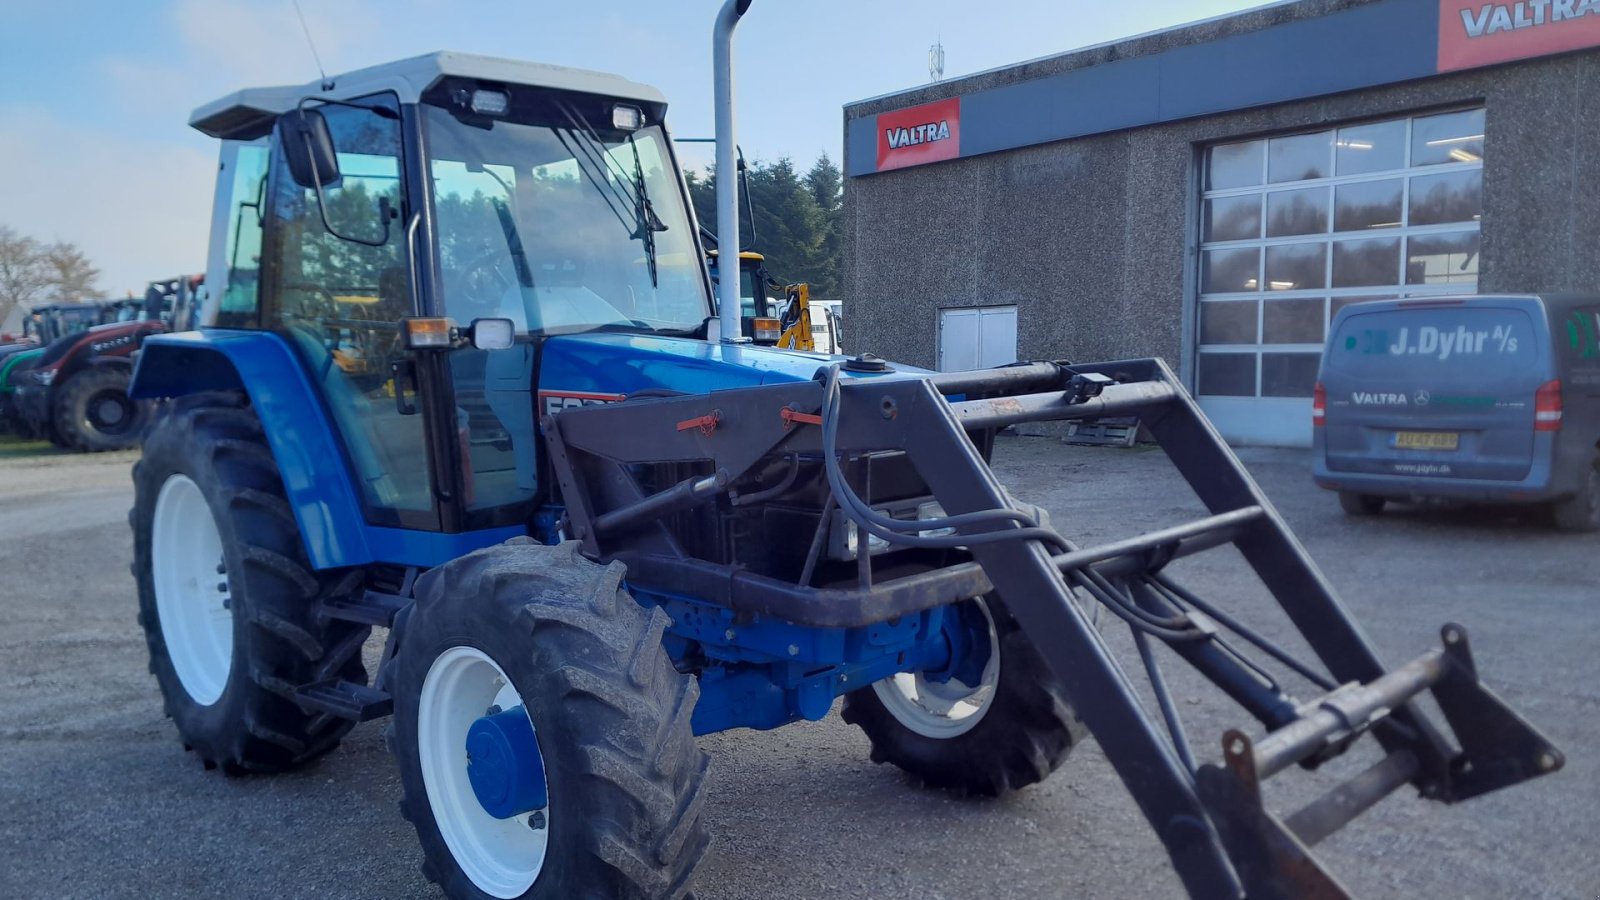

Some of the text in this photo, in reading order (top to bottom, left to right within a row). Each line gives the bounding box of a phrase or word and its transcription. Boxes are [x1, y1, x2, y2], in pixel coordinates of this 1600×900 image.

[1460, 0, 1600, 38] VALTRA
[886, 120, 950, 149] VALTRA
[1390, 325, 1489, 359] J.Dyhr
[1352, 392, 1408, 405] VALTRA
